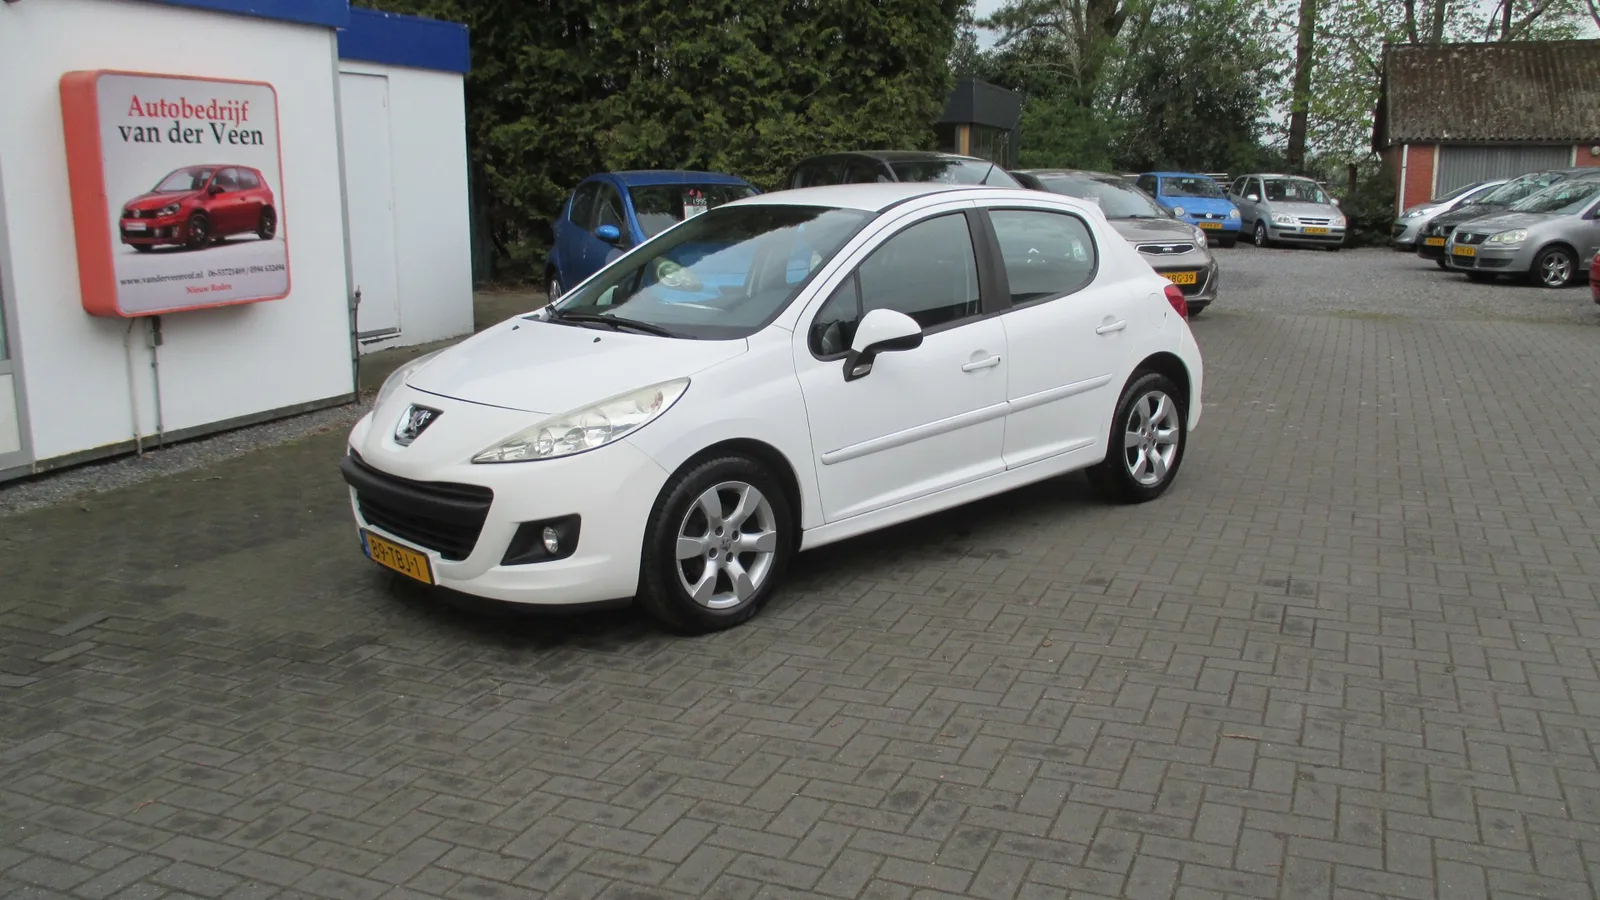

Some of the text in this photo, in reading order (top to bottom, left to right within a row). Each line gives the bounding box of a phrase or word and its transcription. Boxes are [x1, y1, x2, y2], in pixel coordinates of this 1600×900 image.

[128, 94, 249, 128] Autobedrijf
[118, 120, 264, 145] van der Veen
[120, 270, 204, 285] www.vanderveenvof.nl
[186, 282, 232, 294] Nieuw Roden
[370, 539, 421, 577] 89-TBJ-1
